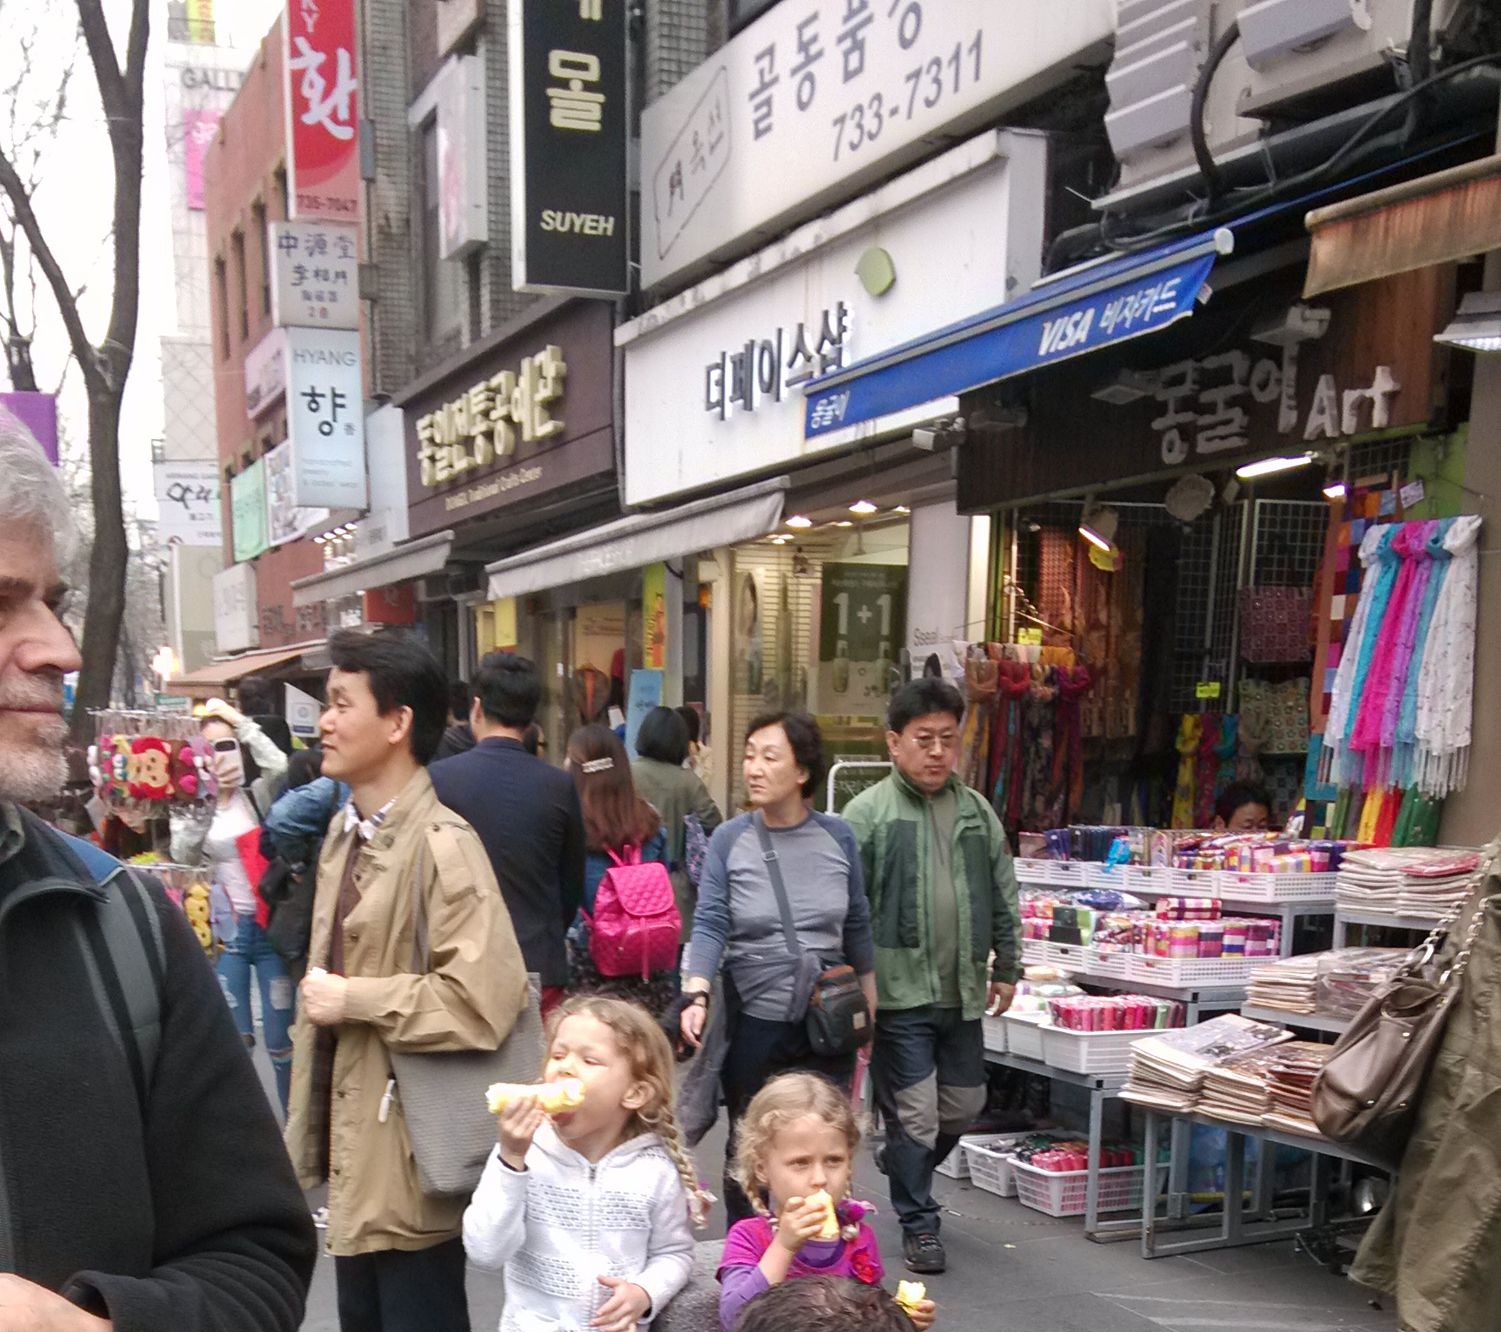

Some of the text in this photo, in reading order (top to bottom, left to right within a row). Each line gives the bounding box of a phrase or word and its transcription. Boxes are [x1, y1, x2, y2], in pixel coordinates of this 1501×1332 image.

[832, 29, 984, 162] 733-7311
[540, 209, 615, 237] SUYEH
[1038, 276, 1182, 357] VISA 비자카드
[294, 350, 357, 366] HYANG
[705, 301, 849, 422] 더페이스샵
[300, 385, 346, 436] 향
[1304, 365, 1401, 441] Art
